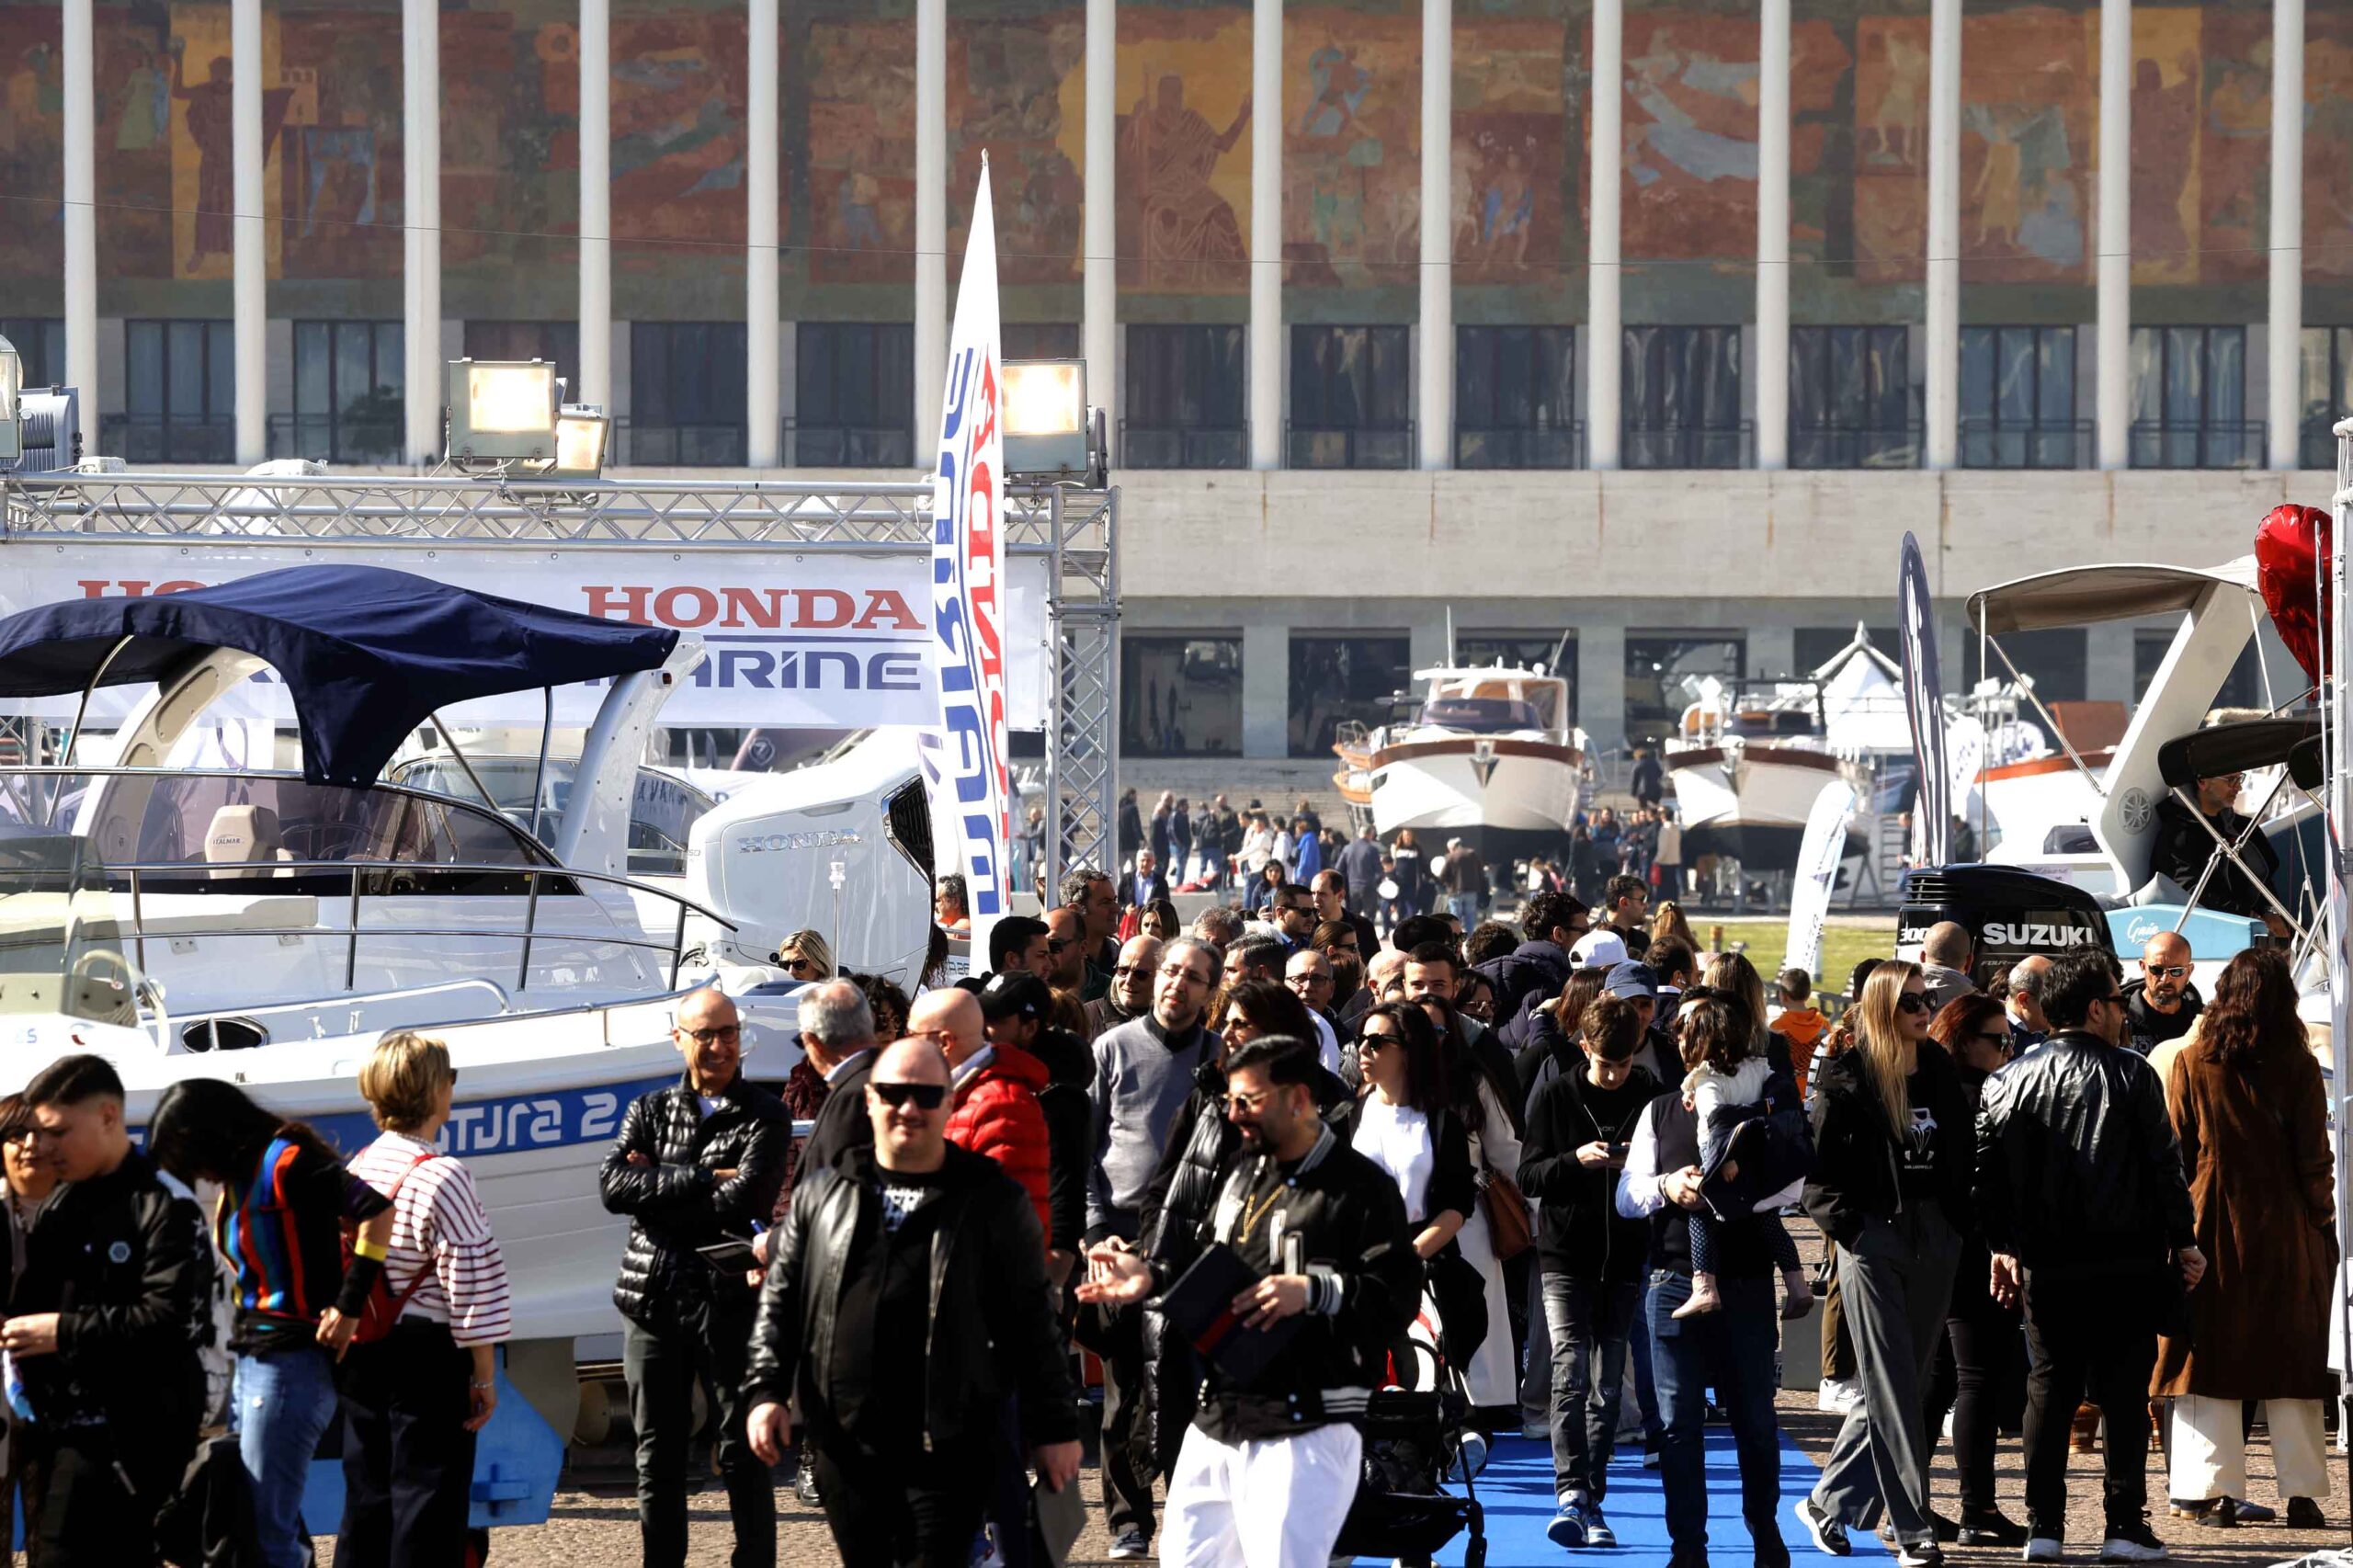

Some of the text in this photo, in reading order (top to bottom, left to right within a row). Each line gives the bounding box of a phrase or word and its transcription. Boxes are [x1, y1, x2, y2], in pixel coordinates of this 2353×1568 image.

[581, 585, 926, 630] HONDA
[737, 828, 864, 855] HONDA
[1983, 922, 2095, 947] SUZUKI
